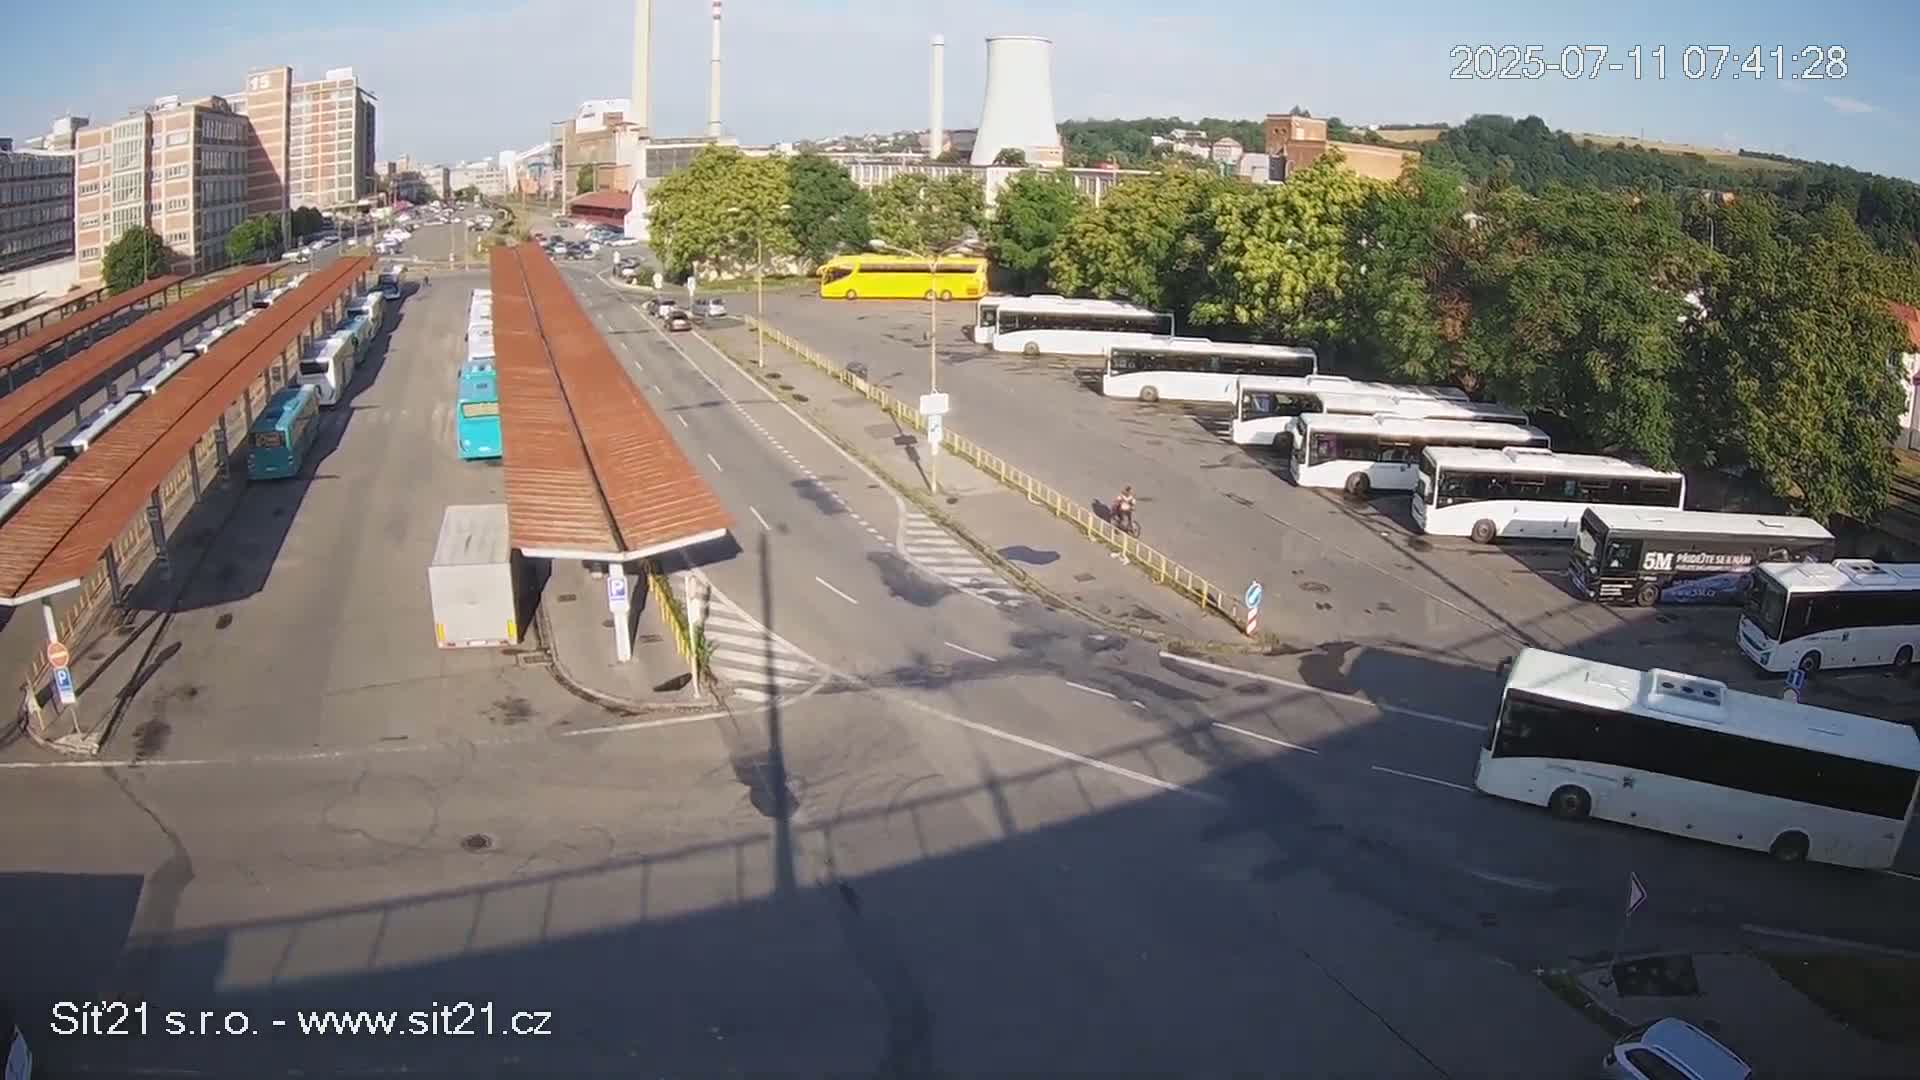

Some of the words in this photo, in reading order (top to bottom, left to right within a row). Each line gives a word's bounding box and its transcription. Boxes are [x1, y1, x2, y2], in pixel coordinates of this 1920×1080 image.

[1643, 552, 1674, 570] 5M
[611, 579, 624, 595] P
[57, 670, 67, 685] P
